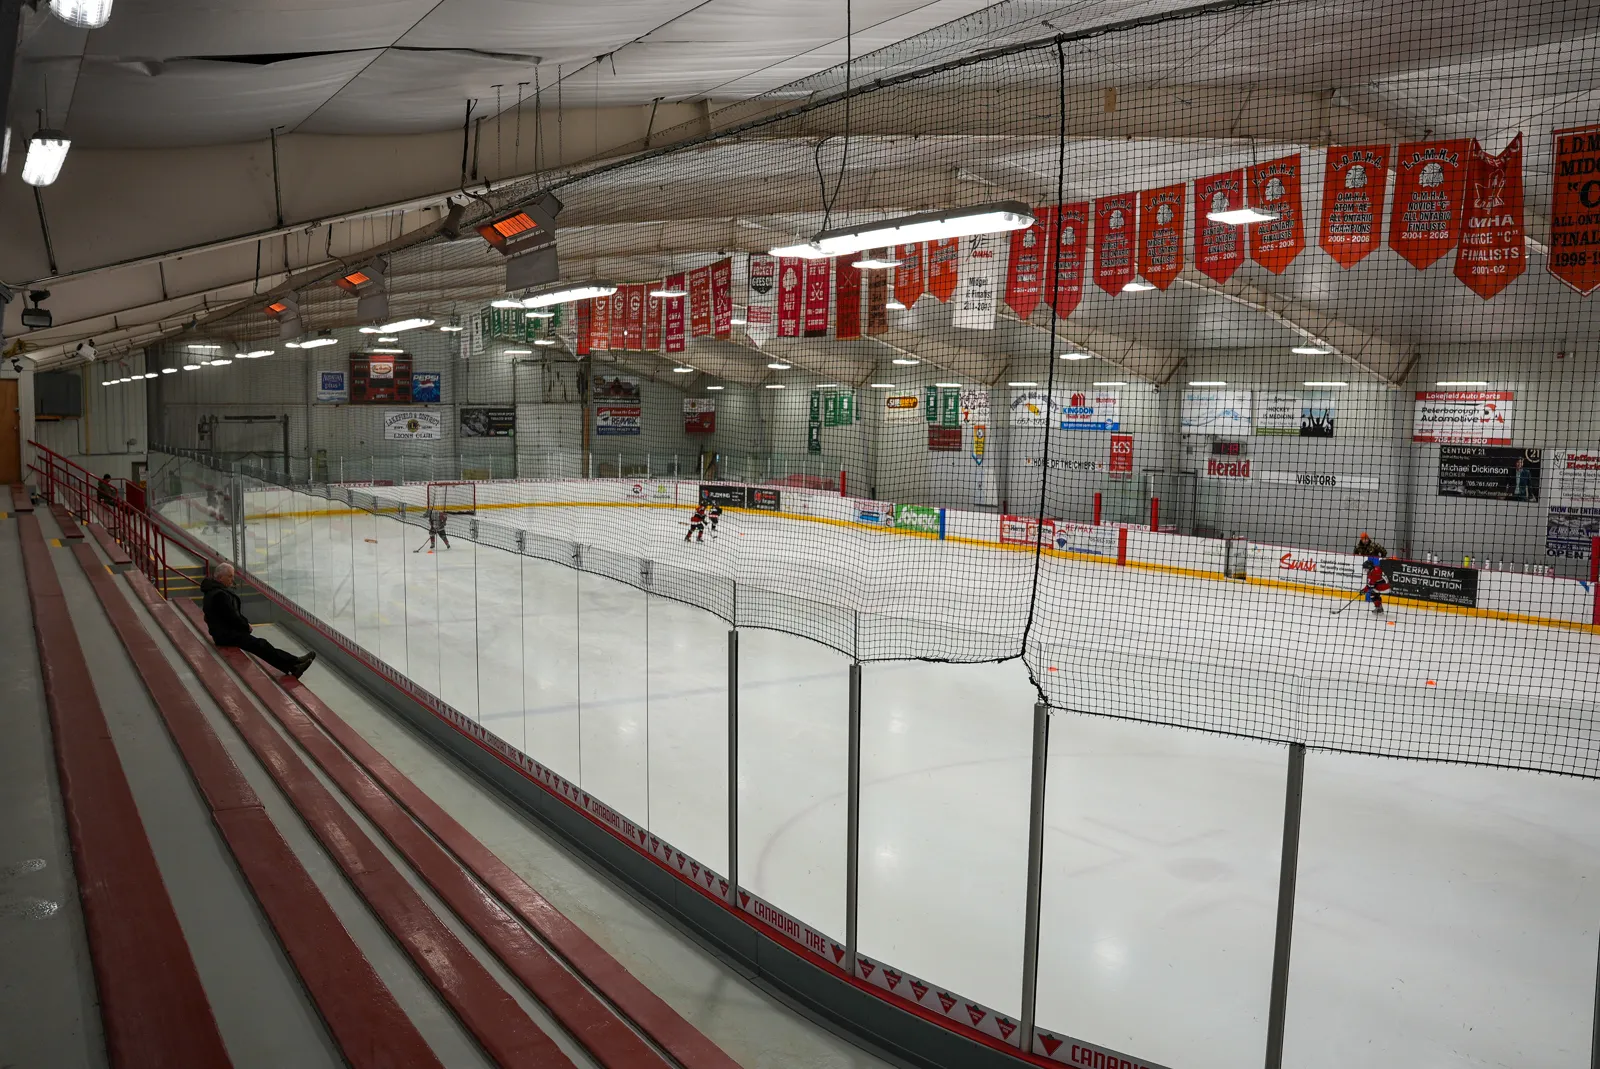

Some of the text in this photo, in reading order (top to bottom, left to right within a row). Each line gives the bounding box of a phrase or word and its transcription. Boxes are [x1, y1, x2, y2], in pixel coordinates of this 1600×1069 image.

[1332, 151, 1382, 171] L.D.M.H.A.
[1402, 148, 1459, 171] L.D.M.H.A.
[1412, 191, 1447, 201] O.M.H.A.
[1333, 203, 1355, 212] ATOM
[1408, 202, 1435, 211] NOVICE
[1329, 213, 1372, 223] ALL ONTARIO
[1404, 211, 1451, 221] ALL ONTARIO
[1554, 215, 1575, 227] ALL
[1329, 223, 1371, 233] CHAMPIONS
[1407, 222, 1446, 232] FINALISTS
[1429, 231, 1449, 239] 2005
[1461, 247, 1519, 261] FINALISTS
[1421, 407, 1479, 416] Peterborough
[1442, 447, 1477, 455] CENTURY
[1530, 449, 1540, 458] 21
[1033, 458, 1096, 470] HOE OF THE CHIEFS
[1207, 458, 1250, 478] Herald
[1441, 463, 1509, 474] Michael Dickinson
[1296, 474, 1336, 486] VISITORS
[1550, 505, 1567, 513] VIEW
[1066, 524, 1093, 534] RE/MAX
[1546, 549, 1583, 559] OPEN
[1280, 553, 1316, 572] Swish
[1401, 564, 1454, 578] TERRA FIRM
[1392, 574, 1462, 590] CONSTRUCTION
[592, 800, 635, 839] CANADIAN TIRE
[754, 900, 826, 954] CANADIAN TIRE
[1071, 1044, 1150, 1069] CANAD
